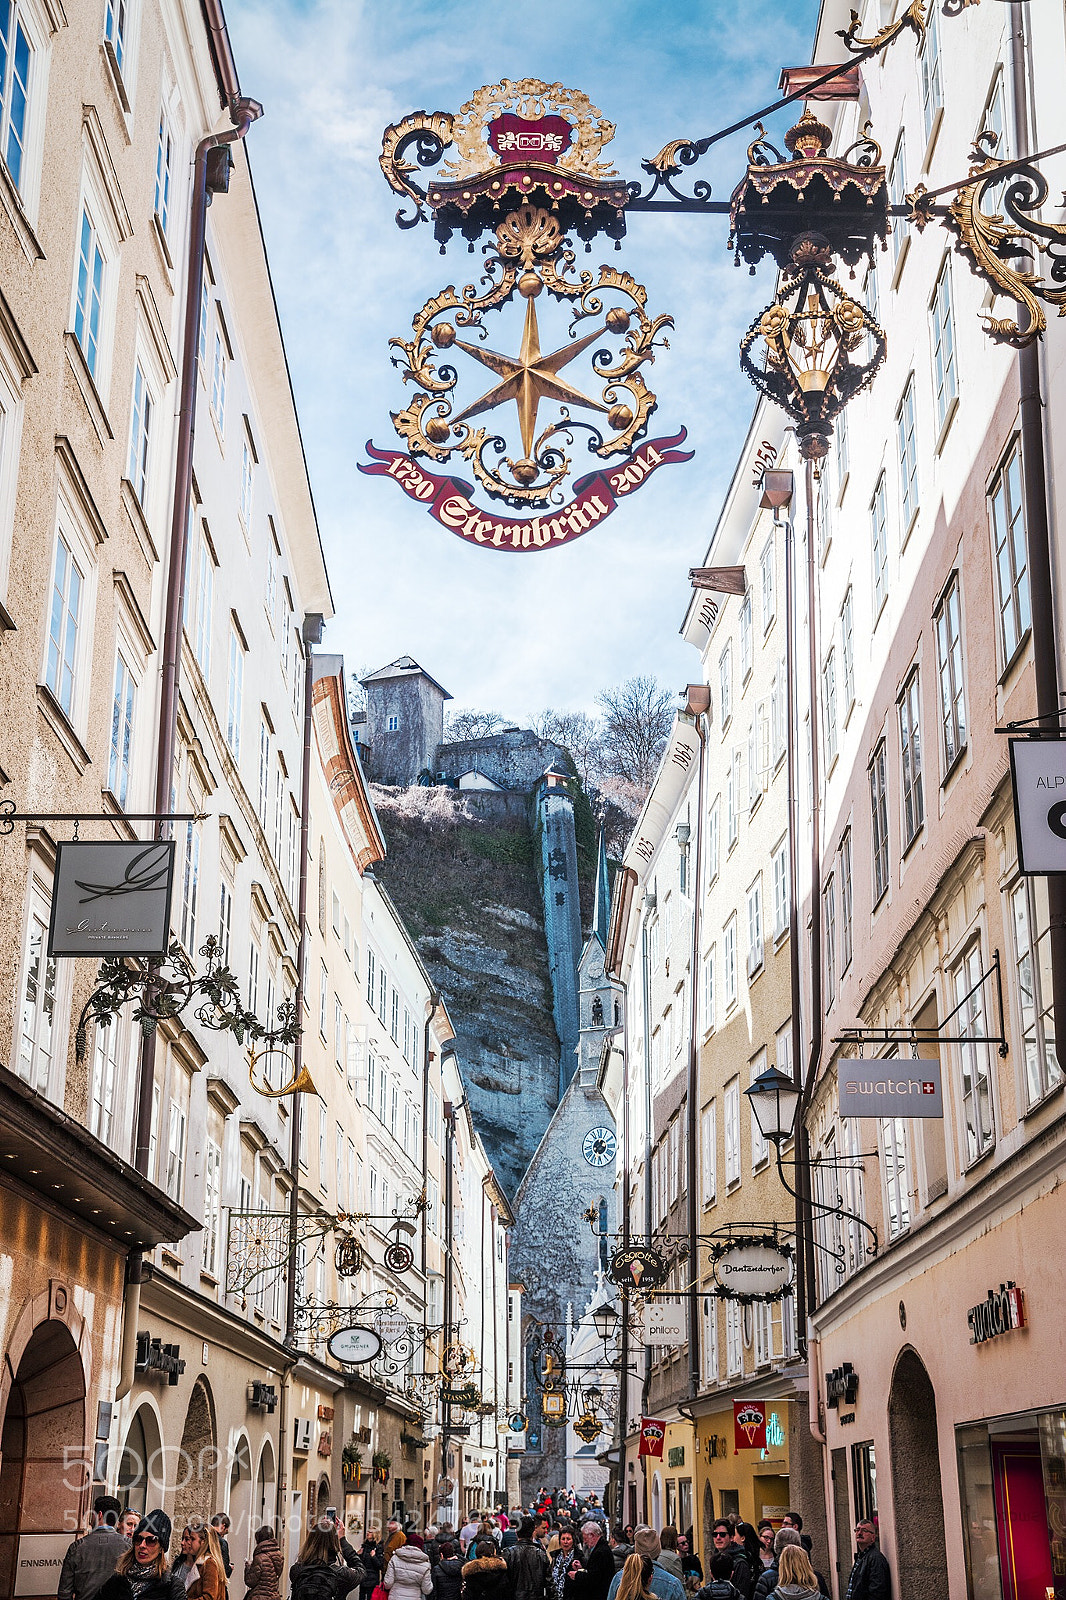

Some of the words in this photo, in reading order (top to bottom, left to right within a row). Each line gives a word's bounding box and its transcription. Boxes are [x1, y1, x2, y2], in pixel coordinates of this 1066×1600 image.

[385, 457, 435, 499] 1720
[439, 495, 609, 549] Sternbräu
[609, 445, 665, 495] 2014
[671, 741, 695, 772] 1964
[1036, 775, 1066, 789] ALP
[634, 836, 655, 863] 1425
[844, 1079, 921, 1095] swatch
[722, 1264, 786, 1275] Dantendorfer
[966, 1283, 1014, 1346] swatch
[649, 1325, 680, 1336] philoro
[442, 1391, 472, 1401] STASSNY
[737, 1412, 763, 1425] EIS
[643, 1428, 663, 1439] EIS
